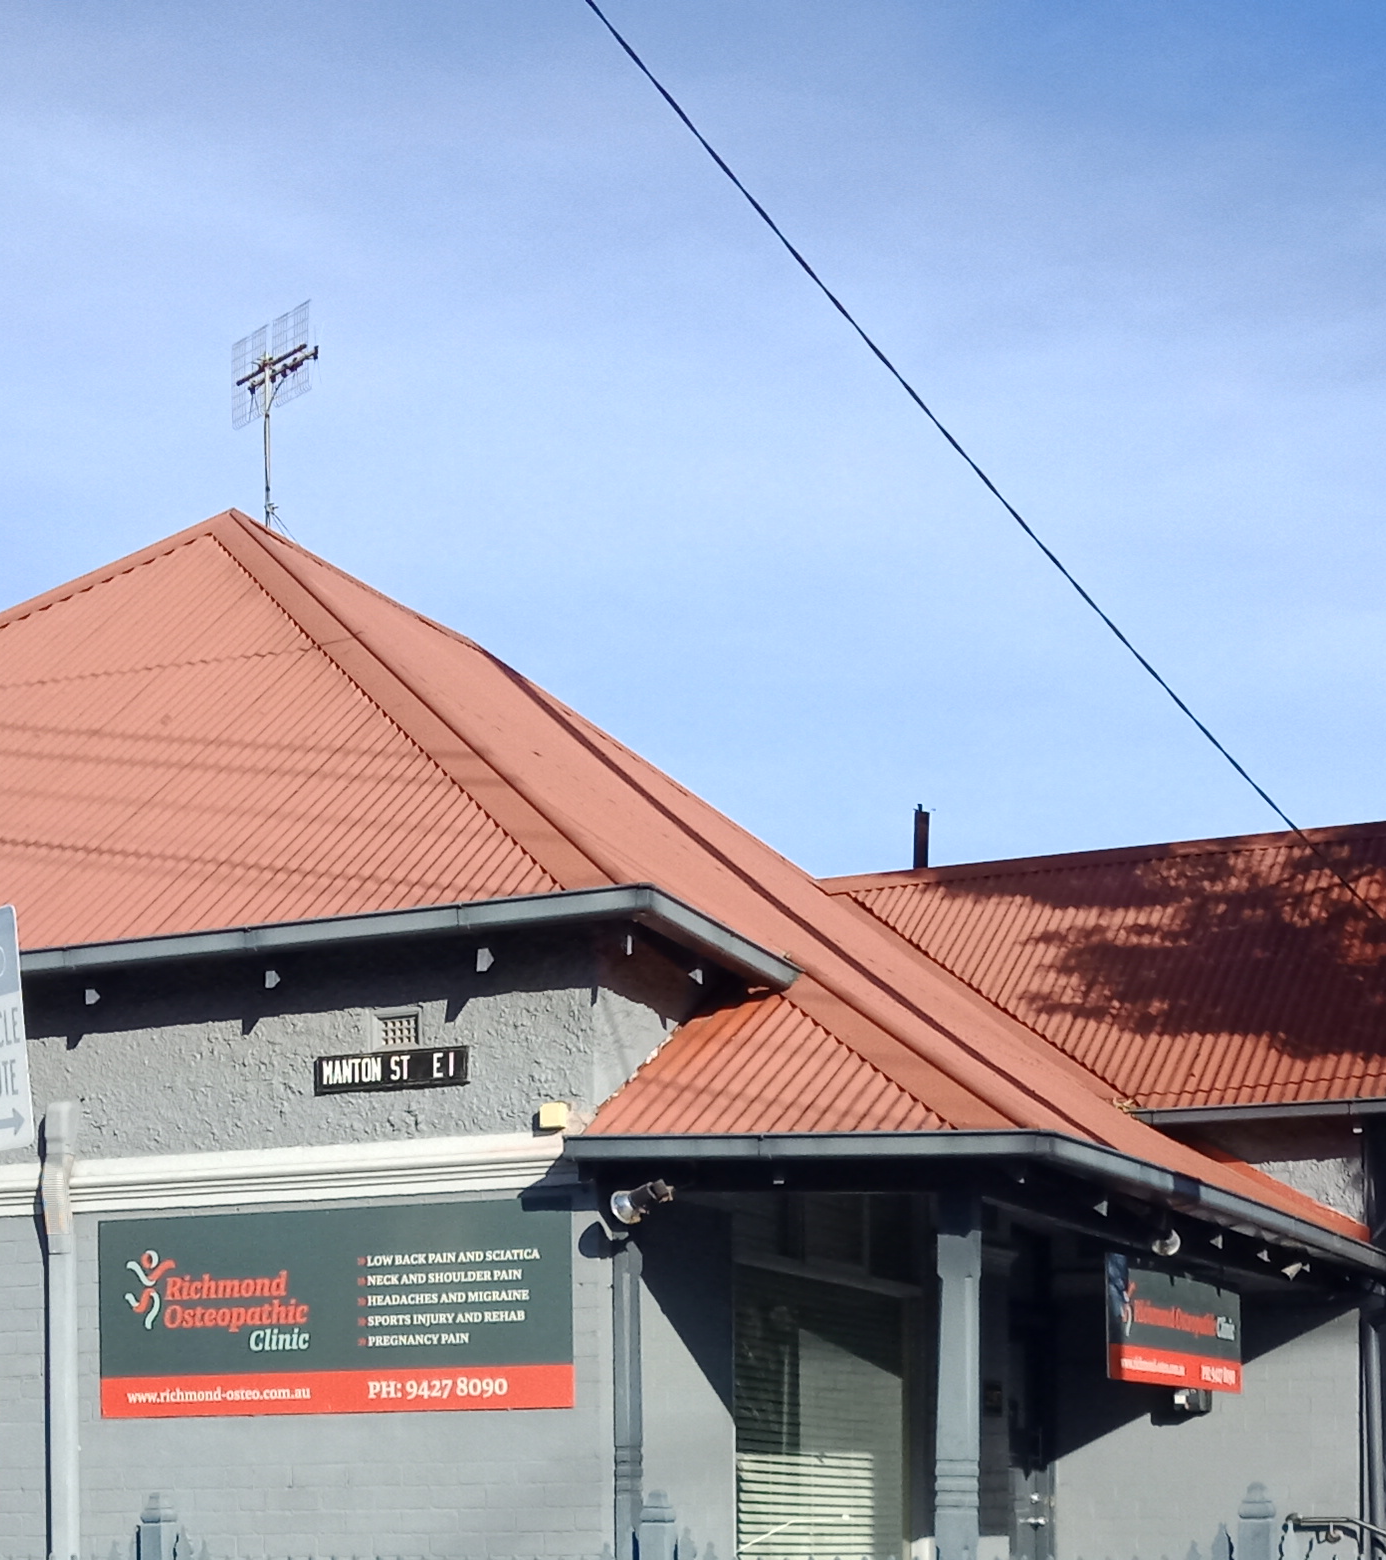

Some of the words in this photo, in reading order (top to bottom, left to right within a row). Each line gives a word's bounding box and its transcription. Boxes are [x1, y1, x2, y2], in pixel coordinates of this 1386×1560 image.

[322, 1056, 382, 1085] MANTON
[390, 1055, 410, 1080] ST
[367, 1255, 394, 1267] LOW
[395, 1253, 427, 1265] BACK
[428, 1252, 456, 1264] PAIN
[457, 1250, 484, 1263] AND
[485, 1248, 541, 1261] SCIATICA
[164, 1269, 288, 1301] Richmond
[367, 1274, 399, 1286] NECK
[400, 1273, 427, 1285] AND
[428, 1270, 492, 1283] SHOULDER
[493, 1269, 522, 1280] PAIN
[367, 1293, 438, 1307] HEADACHES
[440, 1292, 466, 1304] AND
[467, 1289, 530, 1302] MIGRAINE
[164, 1298, 309, 1333] Osteopathic
[367, 1314, 411, 1326] SPORTS
[413, 1313, 455, 1327] INJURY
[456, 1311, 483, 1323] AND
[484, 1310, 525, 1322] REHAB
[249, 1327, 310, 1352] Clinic
[368, 1334, 439, 1347] PREGNANCY
[441, 1333, 470, 1345] PAIN
[126, 1386, 311, 1404] www.richmond-osteo.com.au
[368, 1380, 402, 1399] PH:
[406, 1377, 452, 1400] 9427
[455, 1376, 508, 1397] 8090
